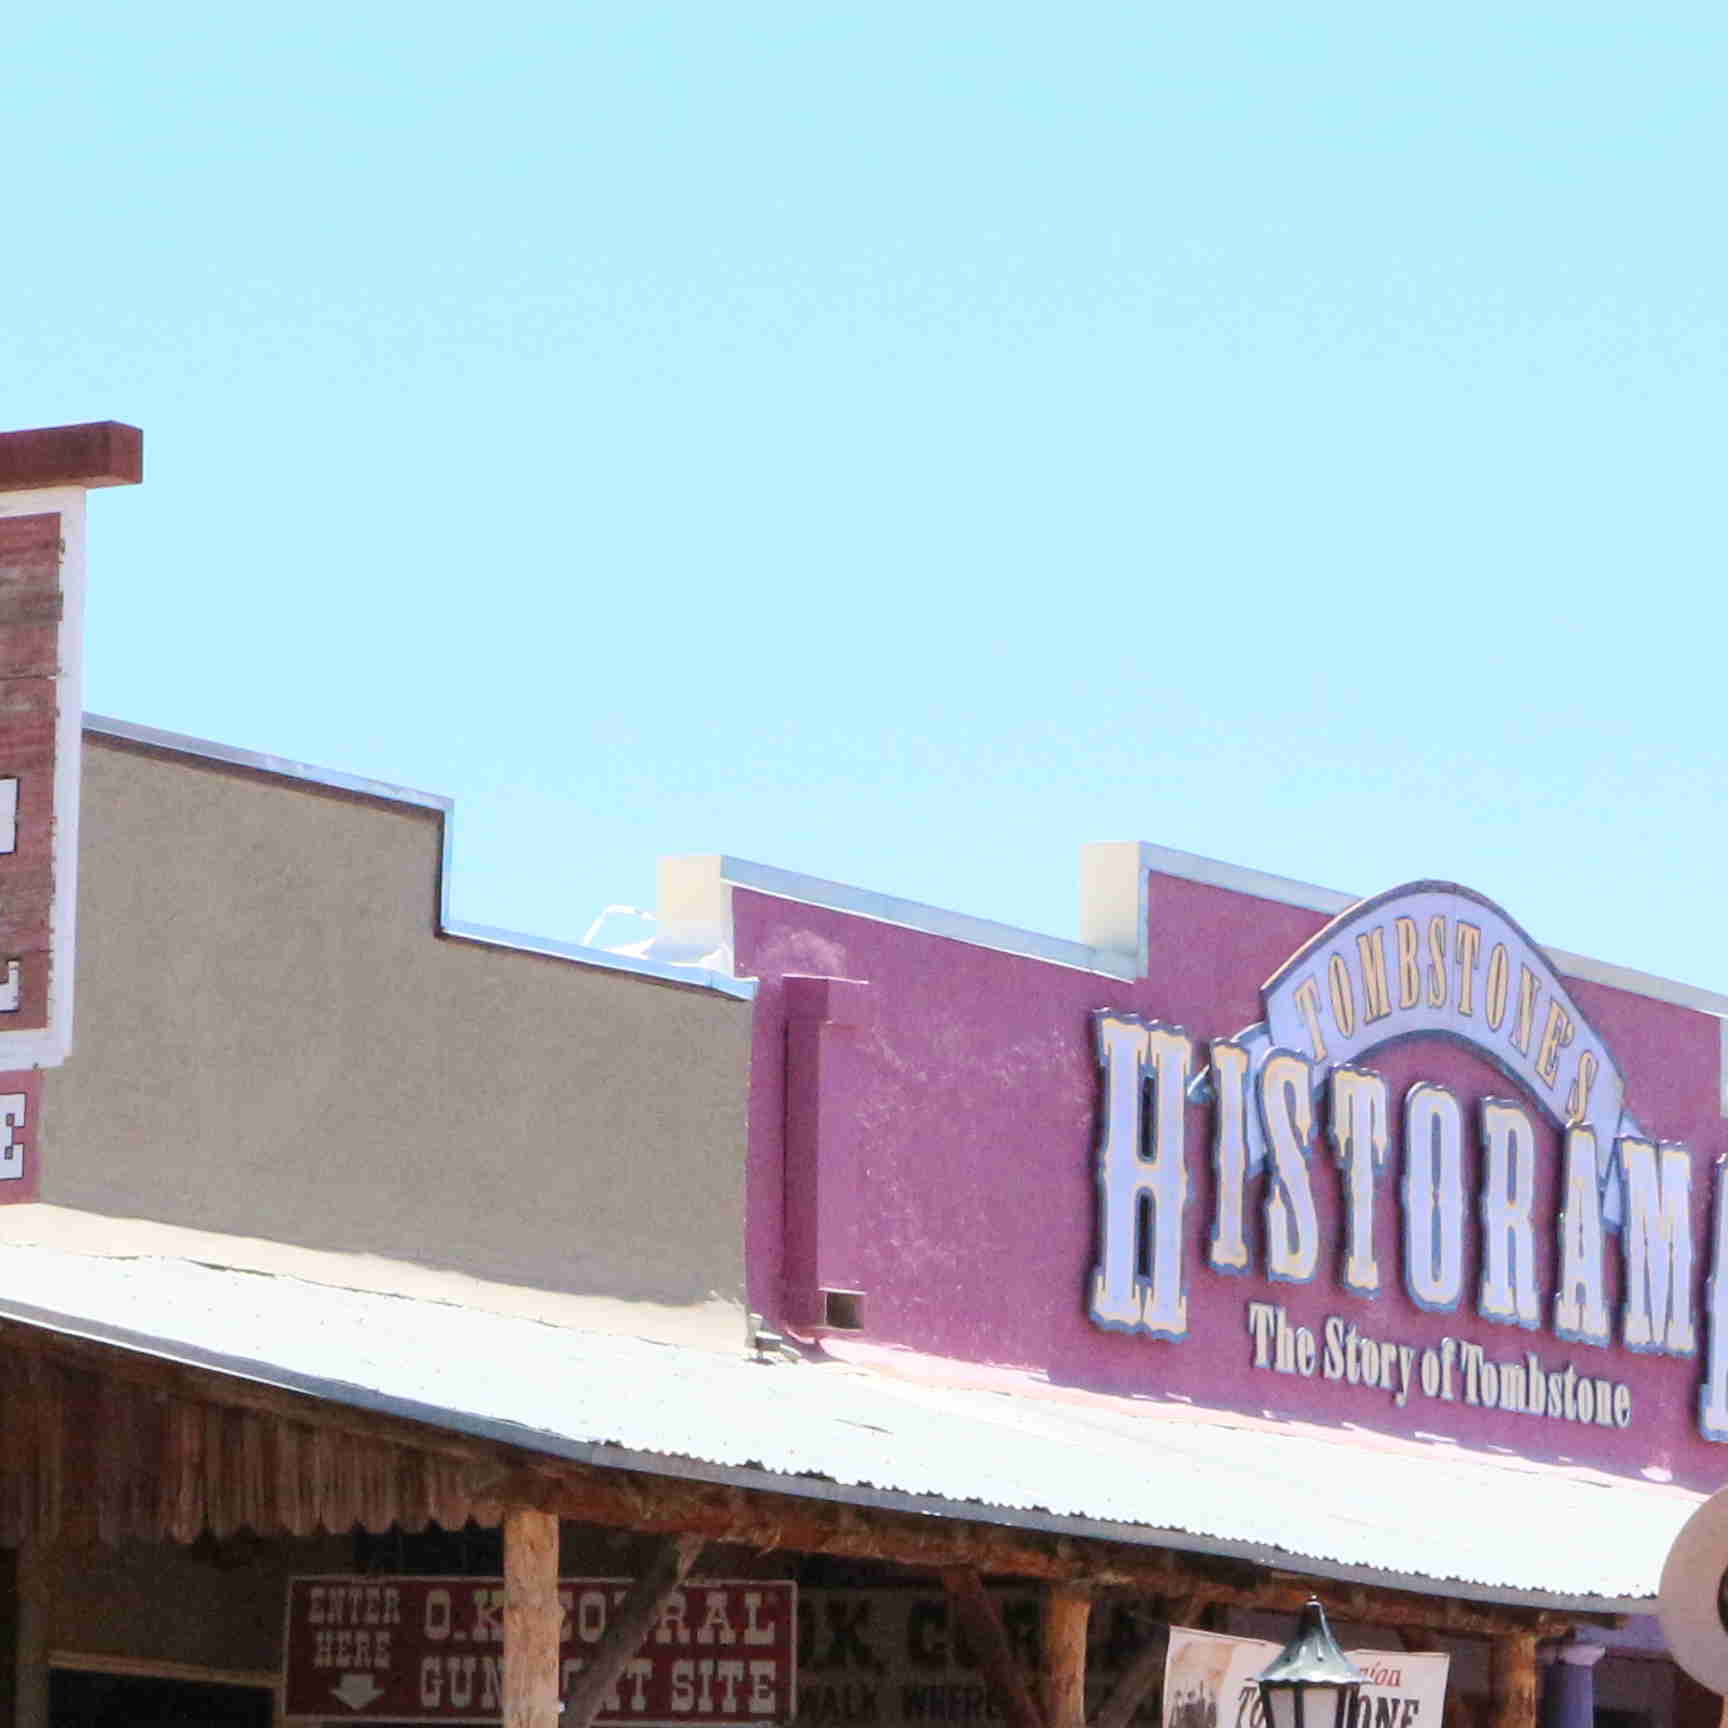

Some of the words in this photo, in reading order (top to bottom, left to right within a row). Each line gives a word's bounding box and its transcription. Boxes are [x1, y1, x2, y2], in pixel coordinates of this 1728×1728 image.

[1294, 914, 1598, 1127] TOMBSTONE'S
[1248, 1301, 1315, 1378] The
[1324, 1315, 1414, 1408] Story
[1421, 1336, 1455, 1402] of
[1459, 1341, 1633, 1429] Tombstone
[309, 1586, 401, 1625] ENTER
[423, 1588, 505, 1641] O.K
[313, 1631, 391, 1670] HERE
[672, 1657, 777, 1714] SITE
